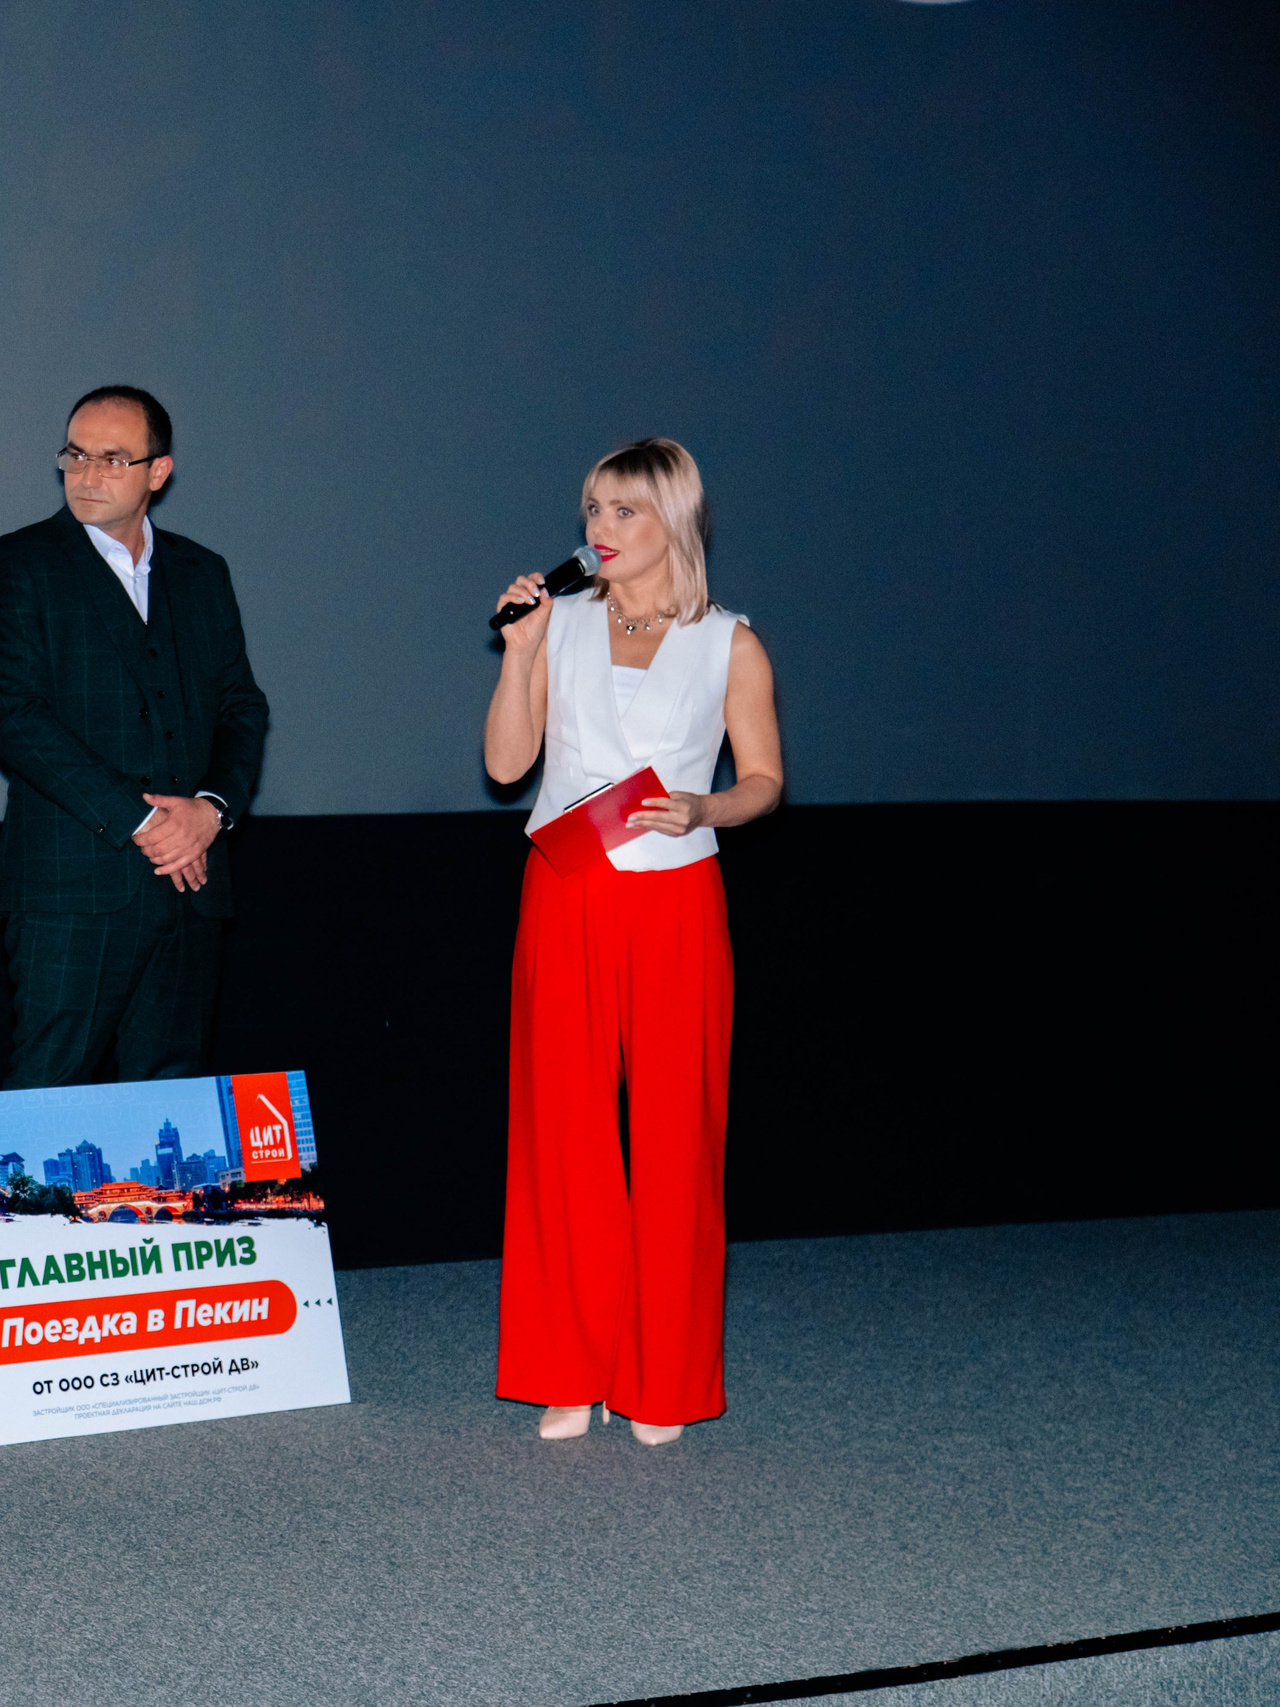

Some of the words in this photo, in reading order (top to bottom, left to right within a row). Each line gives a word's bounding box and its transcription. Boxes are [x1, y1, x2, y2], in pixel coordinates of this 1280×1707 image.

[250, 1124, 282, 1149] ЦИТ
[171, 1236, 257, 1272] ПРИЗ
[1, 1311, 137, 1348] Поездка
[147, 1309, 165, 1332] в
[174, 1297, 269, 1329] Пекин
[32, 1380, 53, 1395] ОТ
[58, 1375, 95, 1392] ООО
[99, 1372, 120, 1387] СЗ
[124, 1357, 223, 1385] «ЦИТ-СТРОЙ
[228, 1357, 259, 1375] ДВ»
[33, 1405, 75, 1417] ЗАСТРОЙЩИК
[170, 1389, 210, 1400] ЗАСТРОЙЩИК
[74, 1410, 110, 1420] ПРОЕКТНАЯ
[111, 1405, 152, 1416] ДЕКЛАРАЦИЯ
[162, 1400, 182, 1409] САЙТЕ
